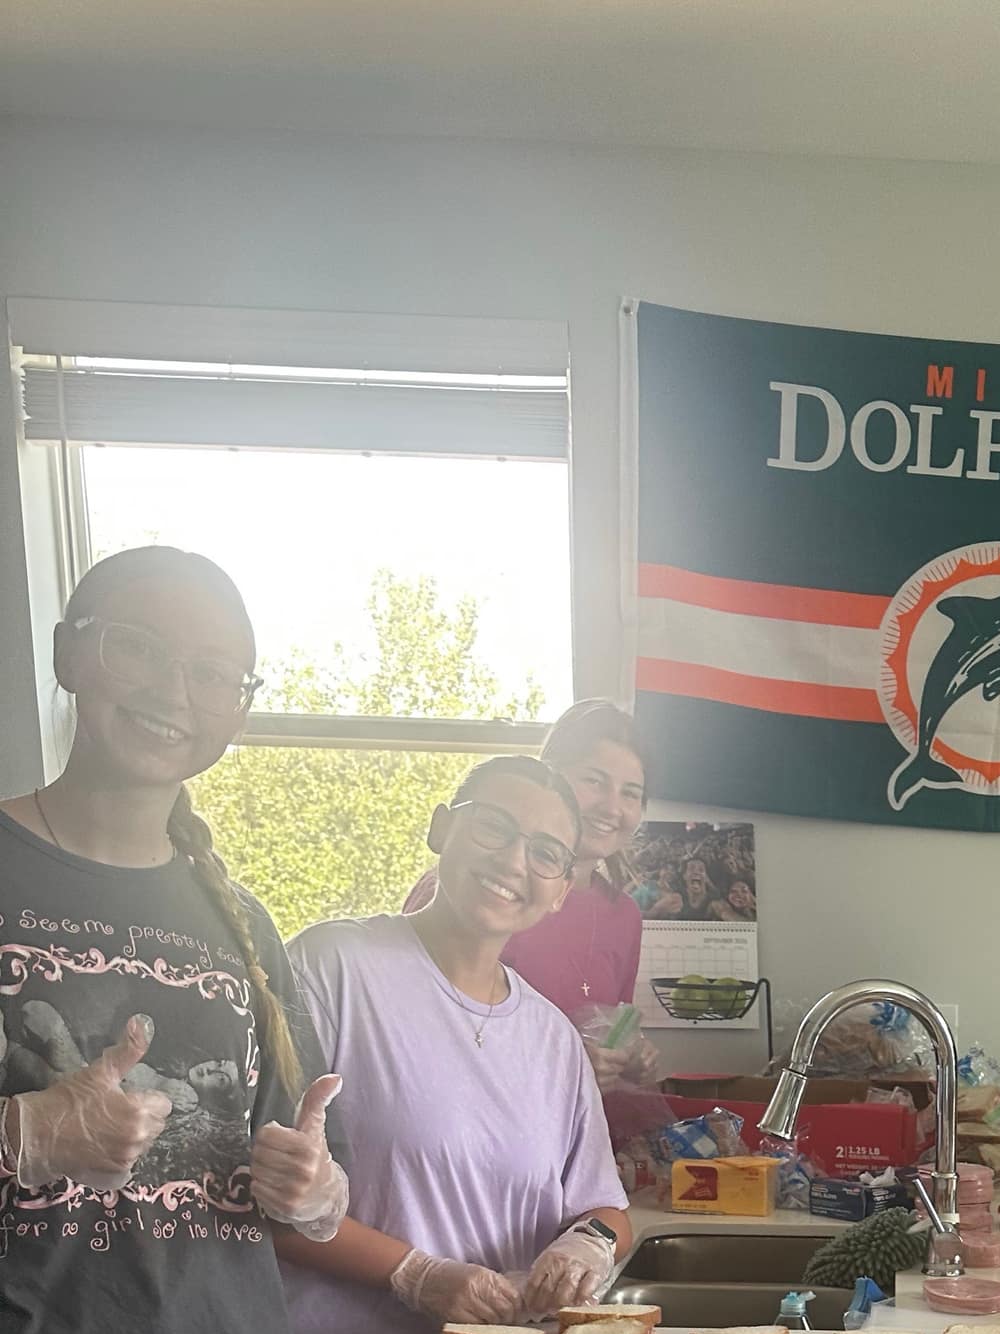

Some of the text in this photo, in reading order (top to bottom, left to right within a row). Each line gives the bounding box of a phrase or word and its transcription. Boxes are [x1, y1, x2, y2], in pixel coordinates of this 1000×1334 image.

[123, 925, 213, 969] pretty
[0, 1208, 263, 1258] for a girl so in love
